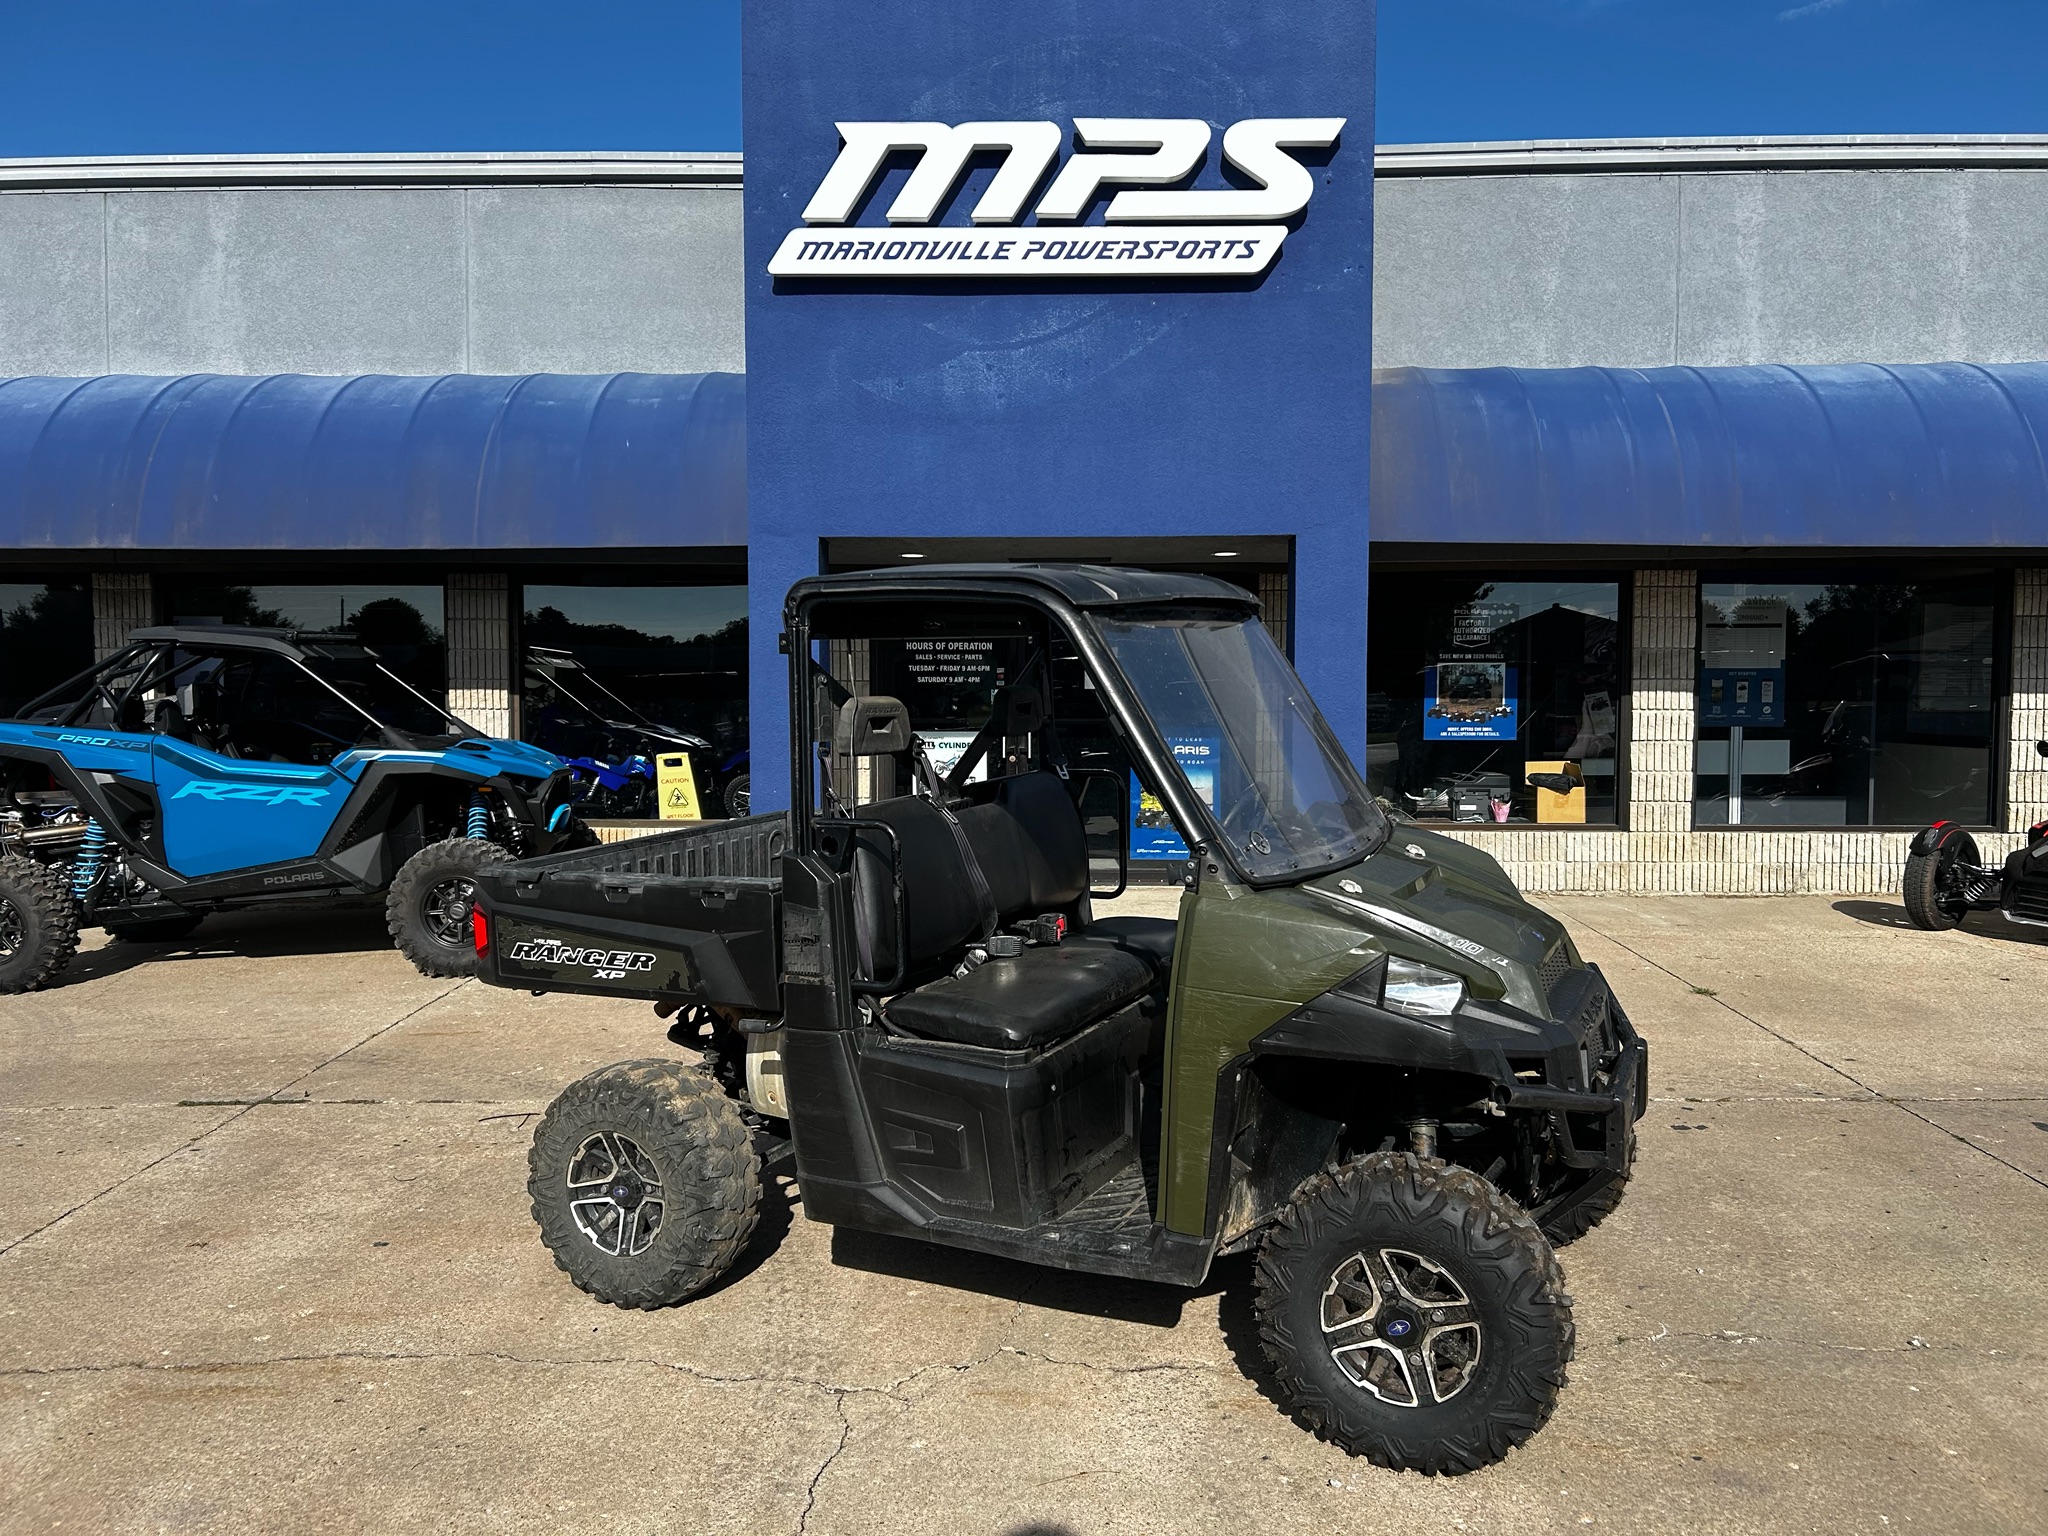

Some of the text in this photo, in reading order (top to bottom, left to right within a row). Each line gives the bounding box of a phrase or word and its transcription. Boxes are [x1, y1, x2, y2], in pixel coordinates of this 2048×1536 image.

[801, 117, 1347, 223] MPS
[796, 239, 1261, 261] MARIONVILLE POWERSPORTS
[906, 642, 993, 650] HOURS OF OPERATION
[864, 706, 902, 716] RANGER
[57, 734, 148, 749] PRO XP
[1171, 745, 1211, 756] ARIS
[660, 777, 690, 785] CAUTION
[170, 780, 331, 807] RZR
[263, 871, 325, 886] POLARIS
[510, 942, 656, 972] RANGER
[592, 968, 627, 980] XP
